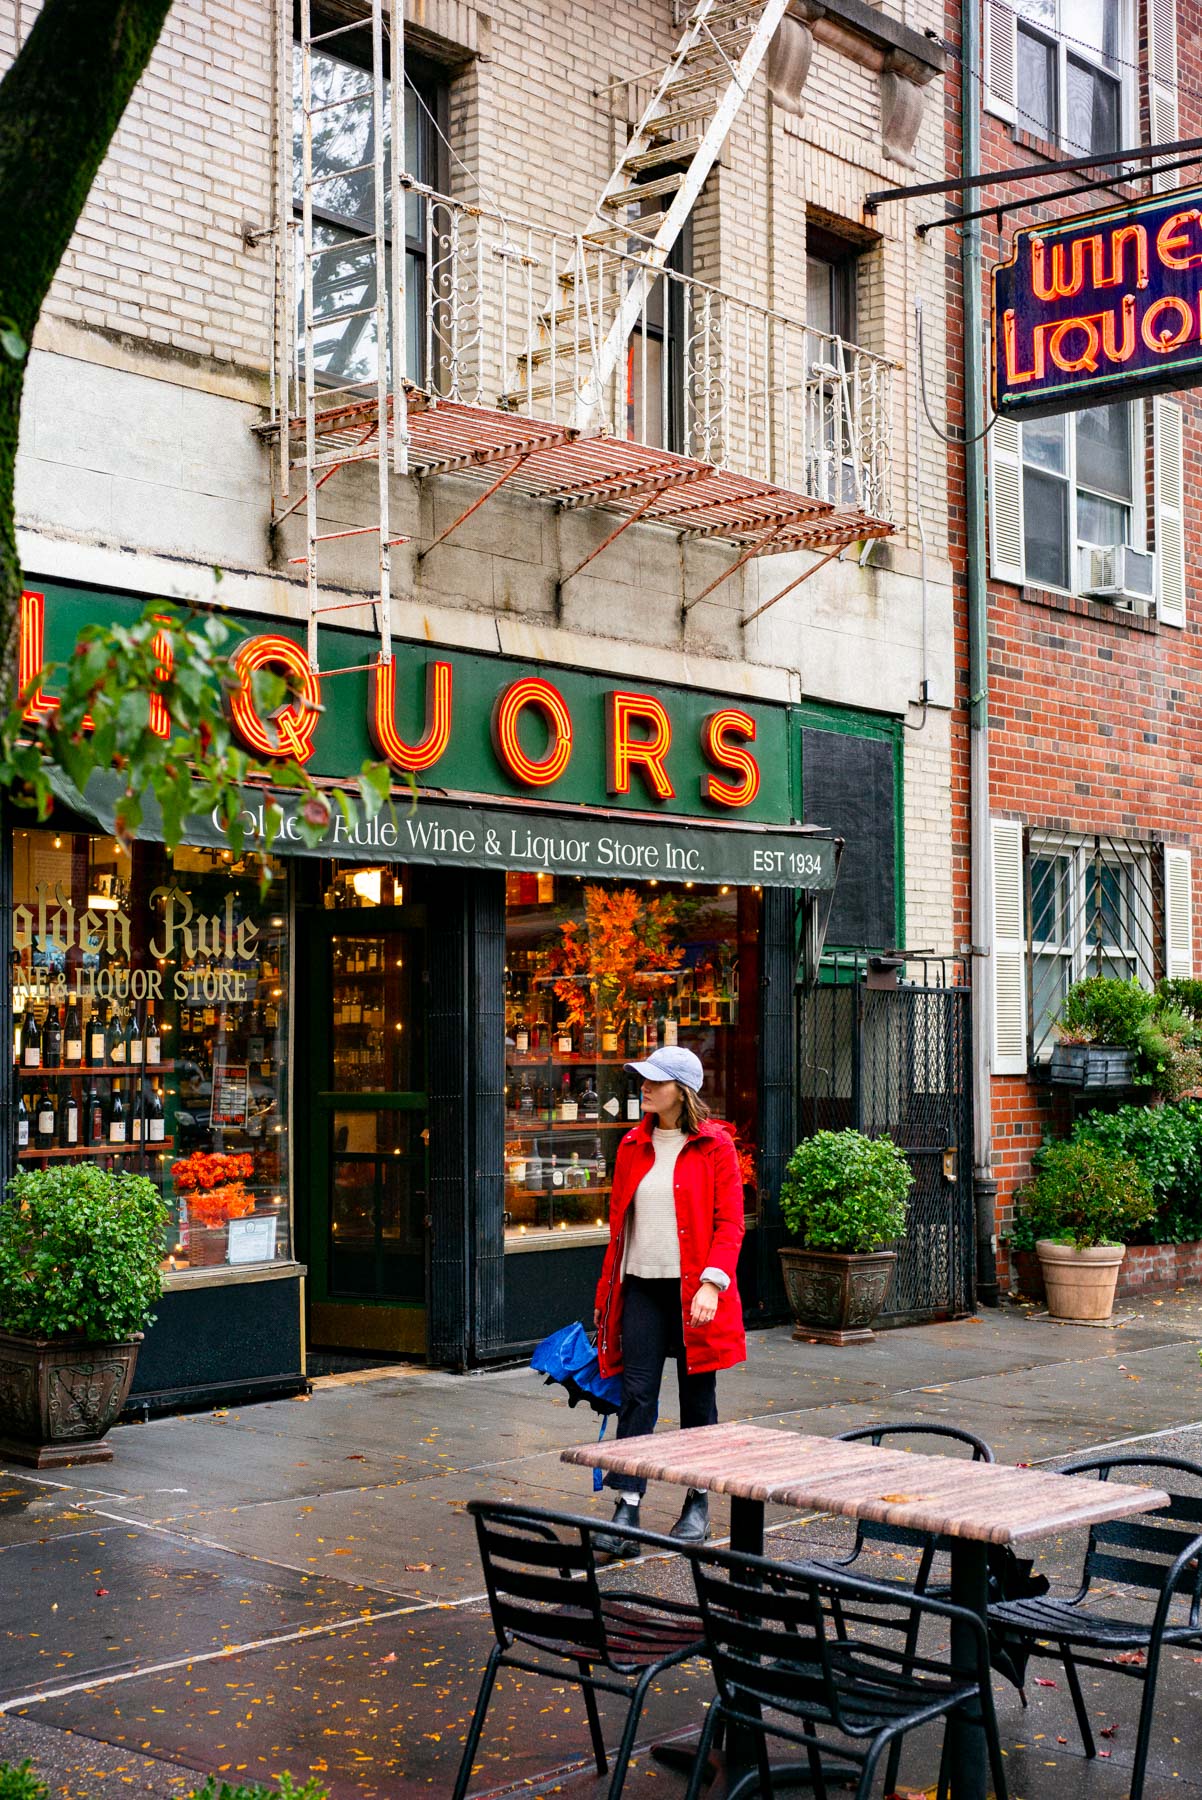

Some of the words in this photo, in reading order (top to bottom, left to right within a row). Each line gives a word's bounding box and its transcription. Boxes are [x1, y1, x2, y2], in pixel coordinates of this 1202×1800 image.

[1032, 209, 1202, 300] WINE
[1004, 294, 1202, 385] LIQUO
[333, 814, 398, 847] Rule
[406, 820, 476, 853] Wine
[485, 829, 503, 856] &
[510, 830, 590, 867] Liquor
[597, 837, 660, 869] Store
[665, 843, 705, 871] Inc.
[753, 850, 785, 872] EST
[789, 853, 822, 875] 1934
[13, 880, 131, 961] olden
[150, 886, 260, 960] Rule
[15, 966, 50, 998] NE
[54, 972, 70, 998] &
[75, 967, 164, 1003] LIQUOR
[174, 971, 248, 1001] STORE
